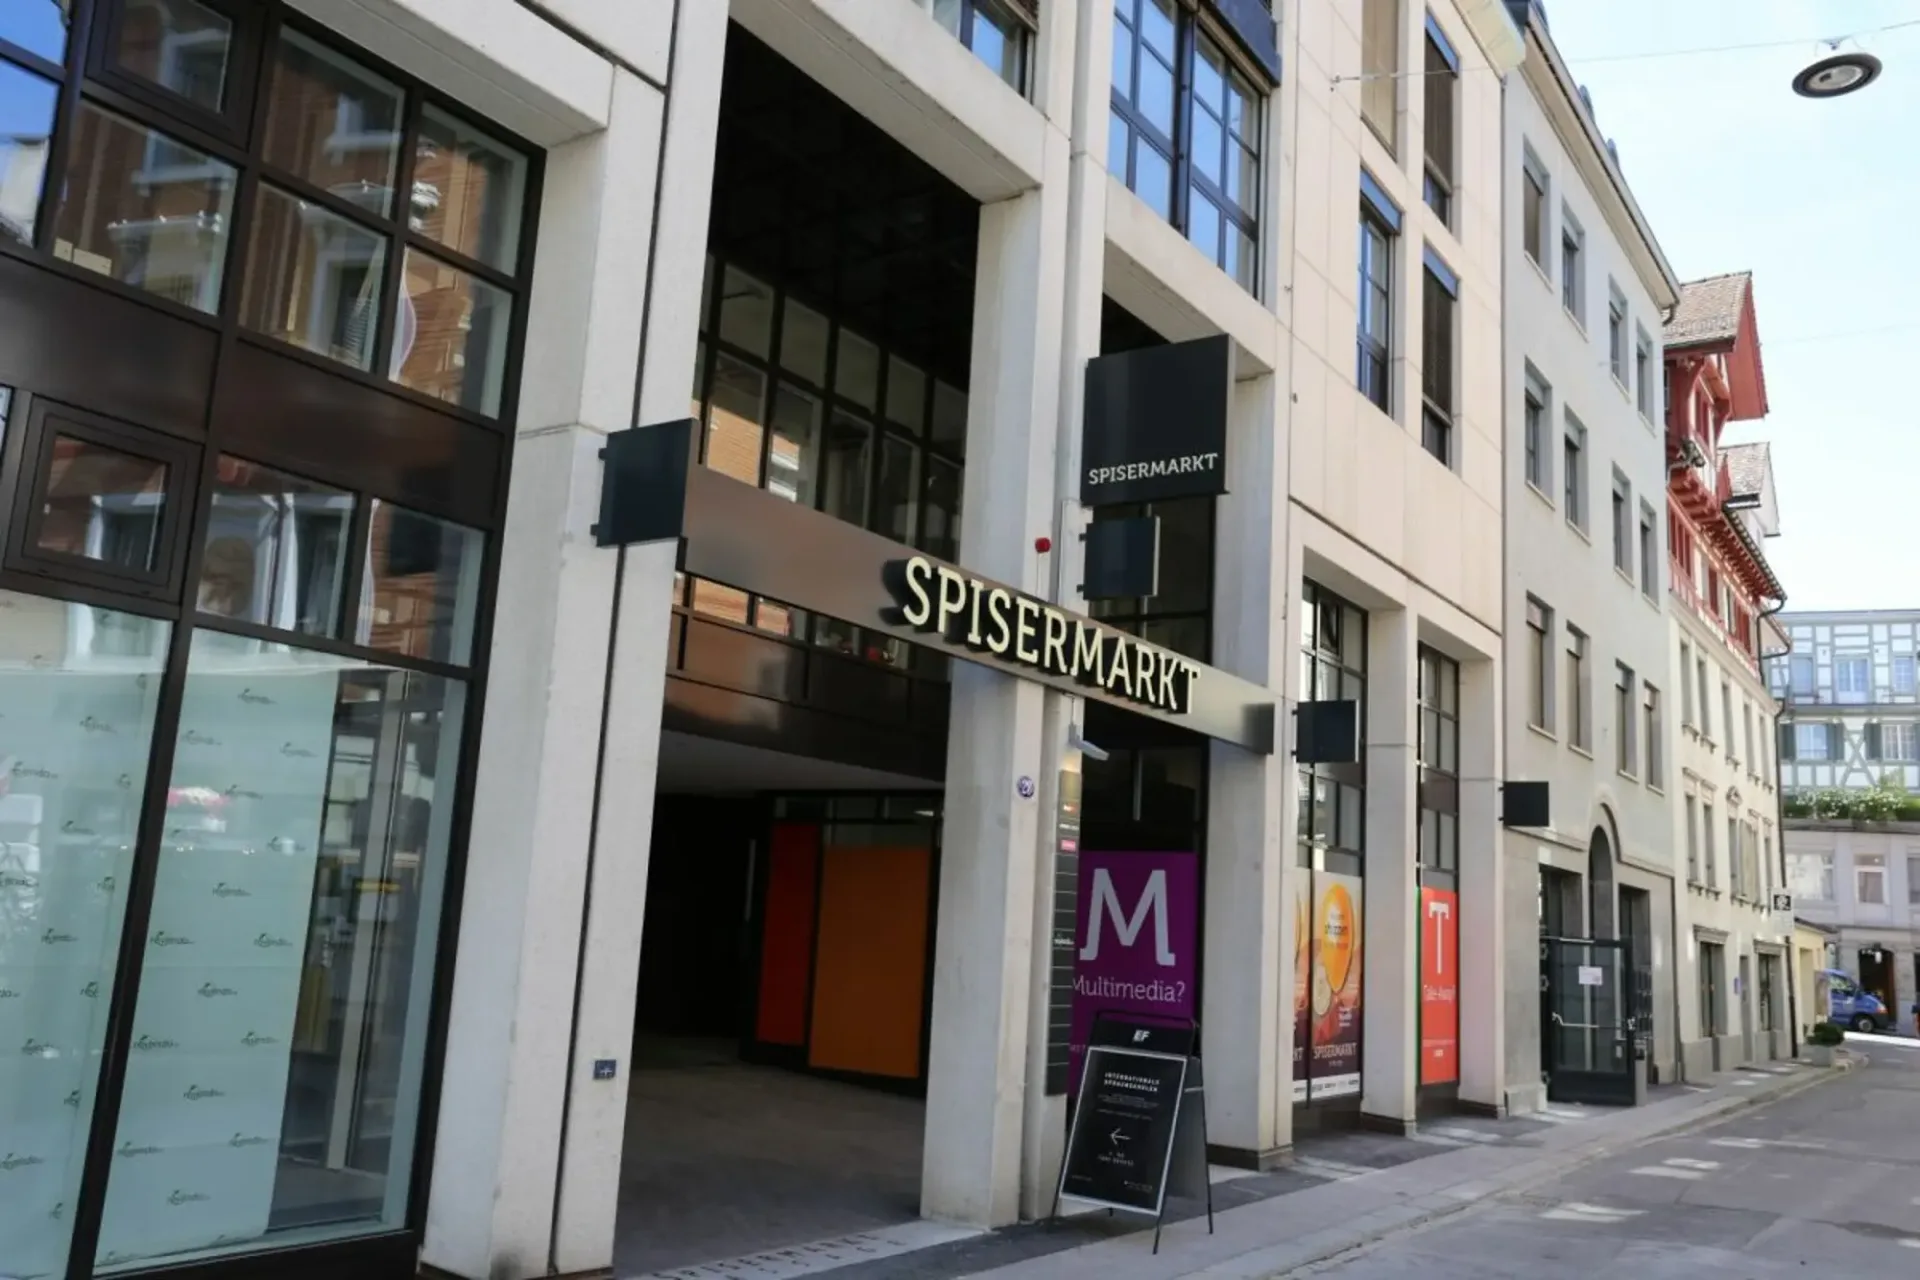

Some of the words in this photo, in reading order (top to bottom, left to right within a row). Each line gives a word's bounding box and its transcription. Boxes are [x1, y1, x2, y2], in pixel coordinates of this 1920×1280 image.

[1088, 453, 1218, 485] SPISERMARKT
[903, 556, 1201, 714] SPISERMARKT
[1080, 868, 1176, 966] M
[1428, 902, 1449, 974] T
[1132, 1029, 1151, 1042] EF
